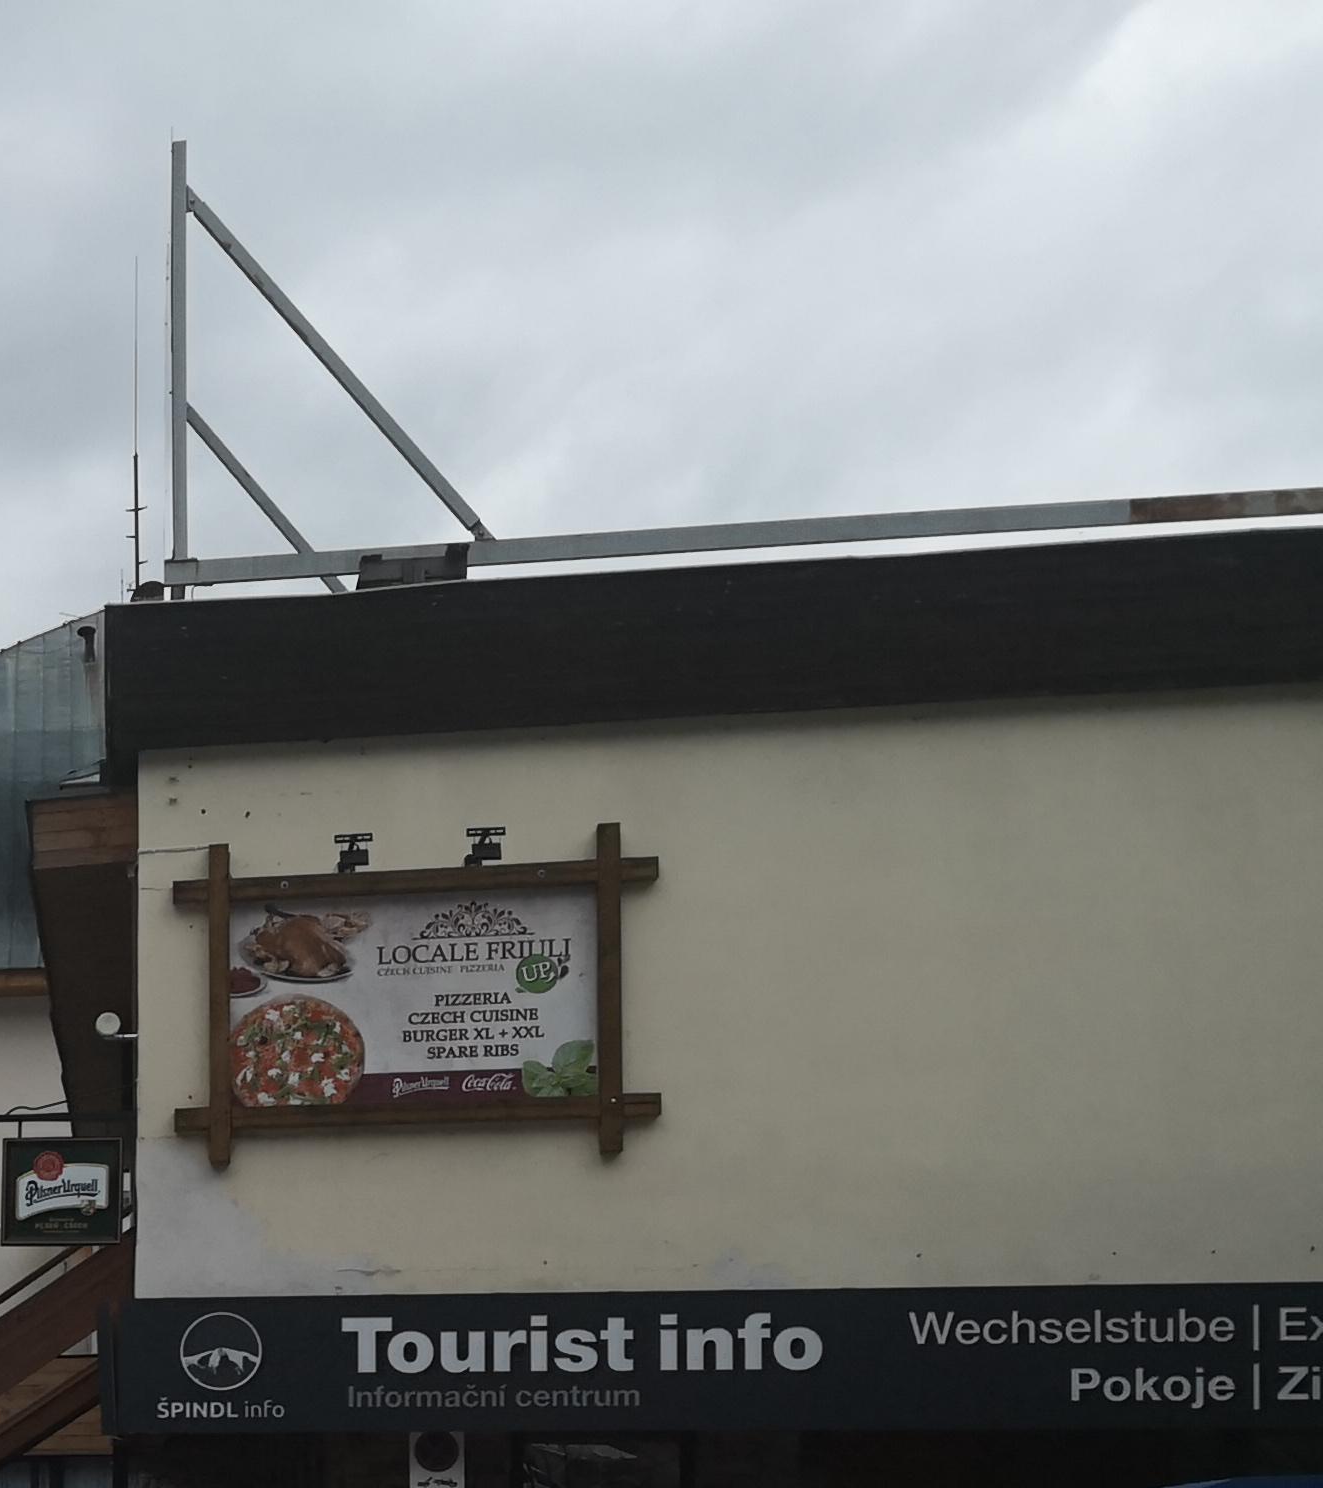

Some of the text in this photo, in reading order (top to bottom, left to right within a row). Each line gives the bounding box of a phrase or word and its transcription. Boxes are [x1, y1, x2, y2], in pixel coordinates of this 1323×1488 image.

[377, 943, 479, 965] LOCALE
[460, 963, 505, 973] PIZZERIA
[435, 992, 512, 1007] PIZZERIA
[409, 1009, 538, 1025] CZECH CUISINE
[403, 1029, 469, 1042] BURGER
[474, 1028, 495, 1040] XL
[512, 1026, 544, 1039] XXL
[427, 1044, 519, 1059] SPARE RIBS
[25, 1179, 98, 1207] Pilsner Urquell
[908, 1307, 1235, 1345] Wechselstube
[341, 1313, 825, 1374] Tourist info
[347, 1384, 640, 1408] Informační centrum
[1070, 1366, 1235, 1409] Pokoje
[1277, 1365, 1322, 1400] Zi
[156, 1396, 285, 1419] ŠPINDL info
